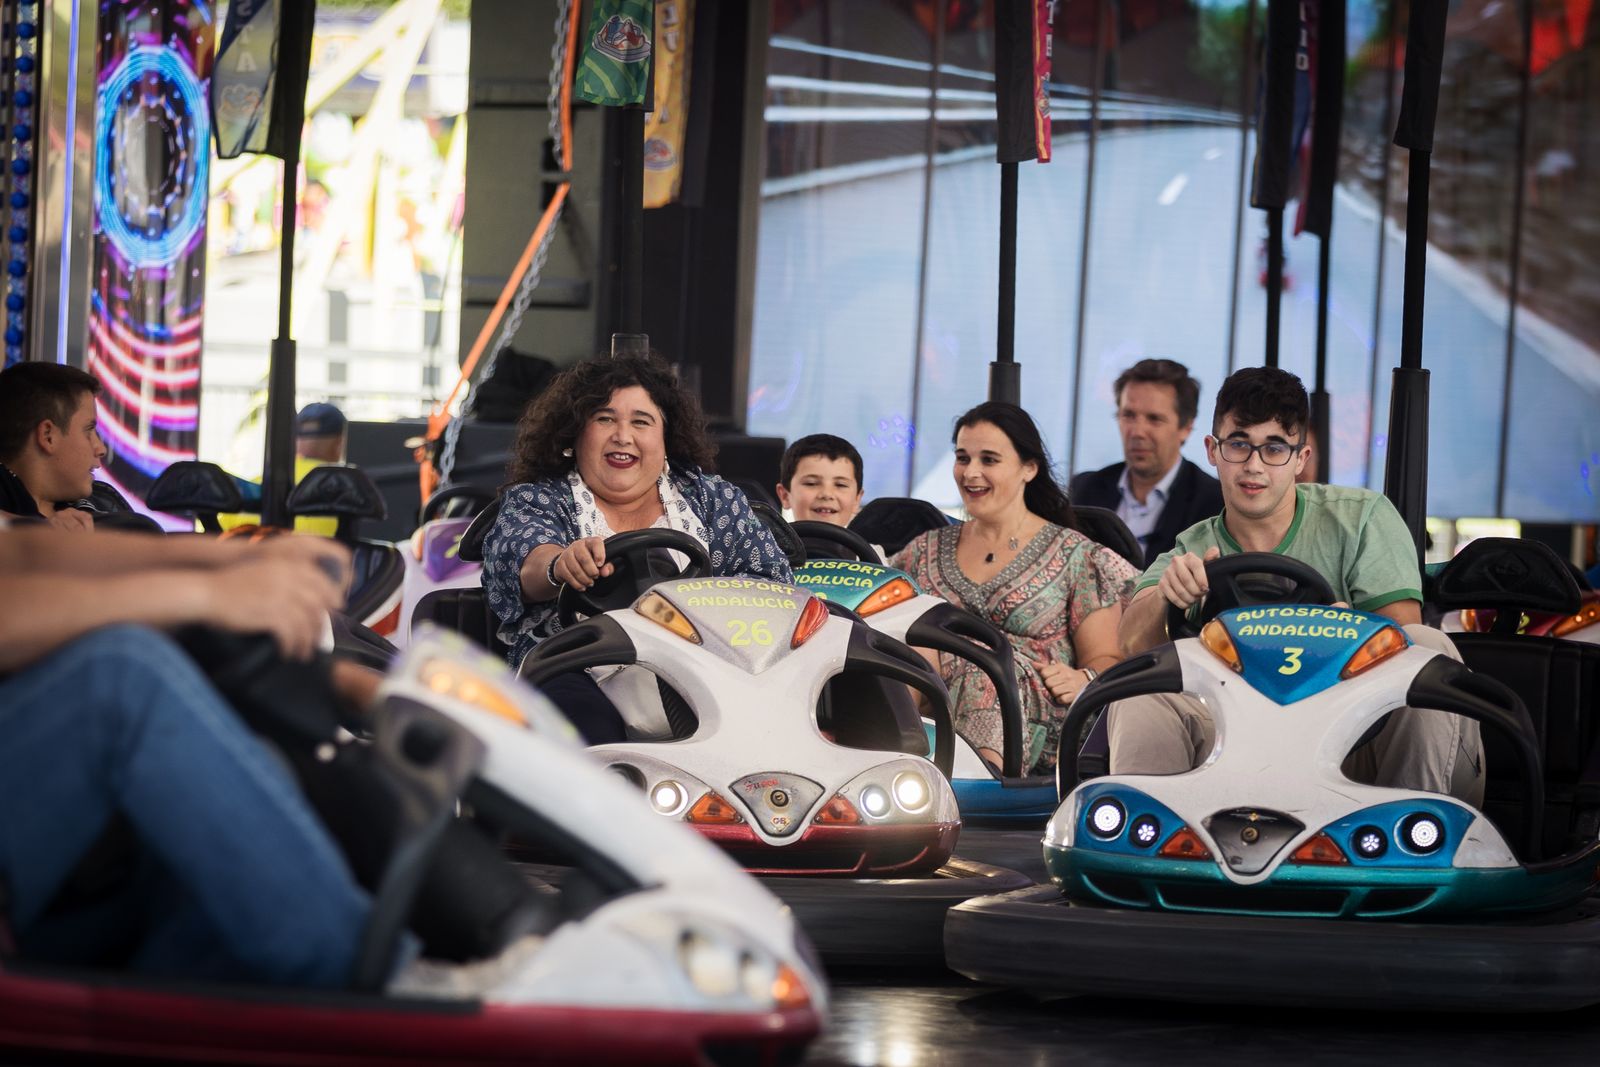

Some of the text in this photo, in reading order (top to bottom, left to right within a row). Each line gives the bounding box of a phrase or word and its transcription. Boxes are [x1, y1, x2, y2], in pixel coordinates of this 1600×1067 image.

[676, 579, 796, 595] AUTOSPORT
[687, 596, 797, 609] ANDALUCIA
[1236, 607, 1368, 625] AUTOSPORT
[727, 619, 773, 647] 26
[1238, 624, 1359, 640] ANDALUCIA
[1278, 646, 1304, 676] 3
